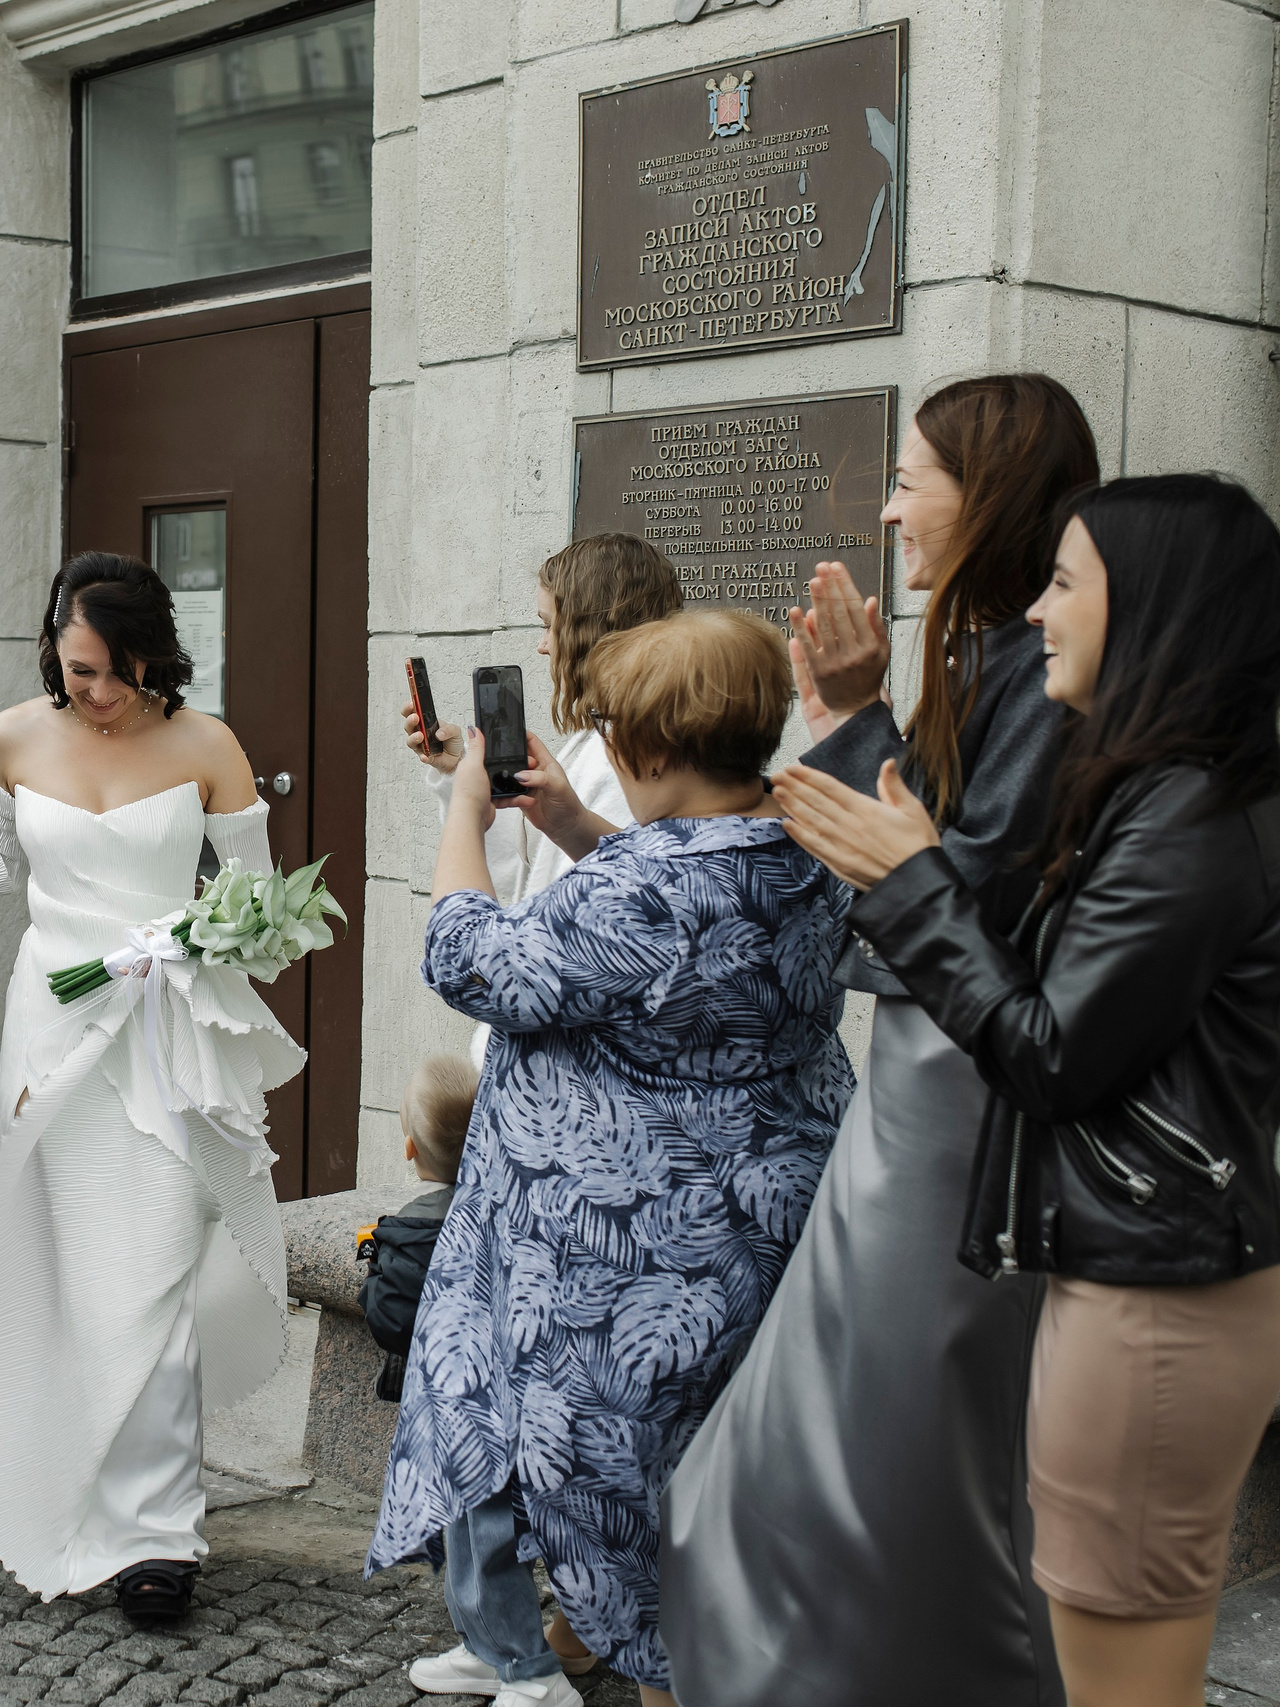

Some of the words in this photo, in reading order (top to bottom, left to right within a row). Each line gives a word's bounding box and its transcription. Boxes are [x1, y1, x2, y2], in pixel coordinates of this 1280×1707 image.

[638, 147, 719, 170] ПРАВИТЕЛЬСТВО
[723, 125, 830, 153] САНКТ-ПЕТЕРБУРГА
[638, 169, 682, 186] КОМИТЕТ
[687, 166, 700, 176] ПО
[704, 158, 741, 174] ДЕЛАМ
[747, 149, 788, 165] ЗАПИСИ
[794, 142, 829, 155] АКТОВ
[657, 172, 738, 195] ГРАЖДАНСКОГО
[743, 159, 809, 179] СОСТОЯНИЯ
[692, 185, 767, 216] ОТДЕЛ
[644, 216, 729, 249] ЗАПИСИ
[739, 202, 817, 233] АКТОВ
[639, 227, 823, 275] ГРАЖДАНСКОГО
[662, 256, 796, 295] СОСТОЯНИЯ
[604, 288, 762, 328] МОСКОВСКОГО
[619, 302, 843, 350] САНКТ-ПЕТЕРБУРГА
[651, 423, 707, 442] ПРИЕМ
[715, 414, 800, 436] ГРАЖДАН
[658, 440, 736, 461] ОТДЕЛОМ
[745, 436, 789, 452] ЗАГС
[629, 458, 747, 481] МОСКОВСКОГО
[755, 451, 821, 472] РАЙОНА
[622, 484, 743, 503] ВТОРНИК-ПЯТНИЦА
[645, 505, 701, 520] СУББОТА
[644, 524, 701, 539] ПЕРЕРЫВ
[837, 533, 873, 548] ДЕНЬ
[711, 561, 797, 580] ГРАЖДАН
[726, 582, 795, 600] ОТДЕЛА
